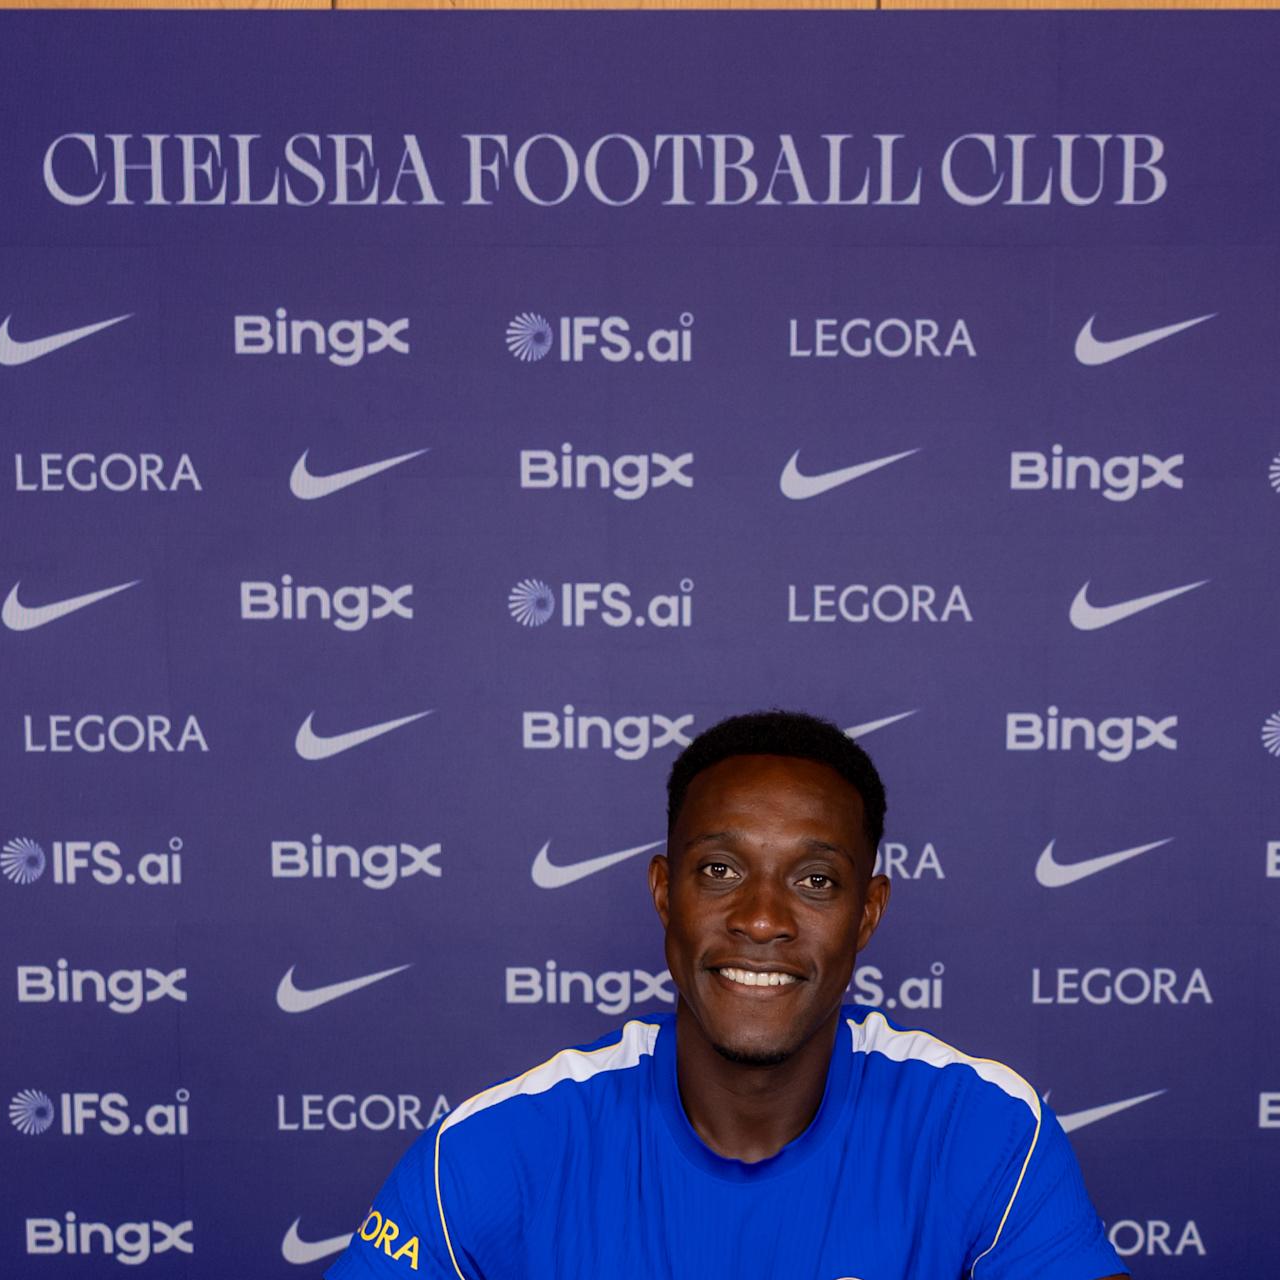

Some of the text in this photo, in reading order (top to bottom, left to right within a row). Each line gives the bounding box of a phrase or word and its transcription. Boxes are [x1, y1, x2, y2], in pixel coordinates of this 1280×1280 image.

[42, 132, 1168, 207] CHELSEA FOOTBALL CLUB
[559, 311, 695, 363] IFS.ai
[789, 317, 977, 358] LEGORA
[14, 452, 203, 492] LEGORA
[561, 577, 694, 628] IFS.ai
[788, 584, 973, 623] LEGORA
[23, 714, 210, 753] LEGORA
[52, 836, 184, 885] IFS.ai
[845, 960, 946, 1010] S.ai
[1031, 967, 1214, 1005] LEGORA
[60, 1088, 190, 1136] IFS.ai
[276, 1093, 452, 1131] LEGORA
[358, 1208, 420, 1271] ORA
[1107, 1219, 1208, 1257] ORA
